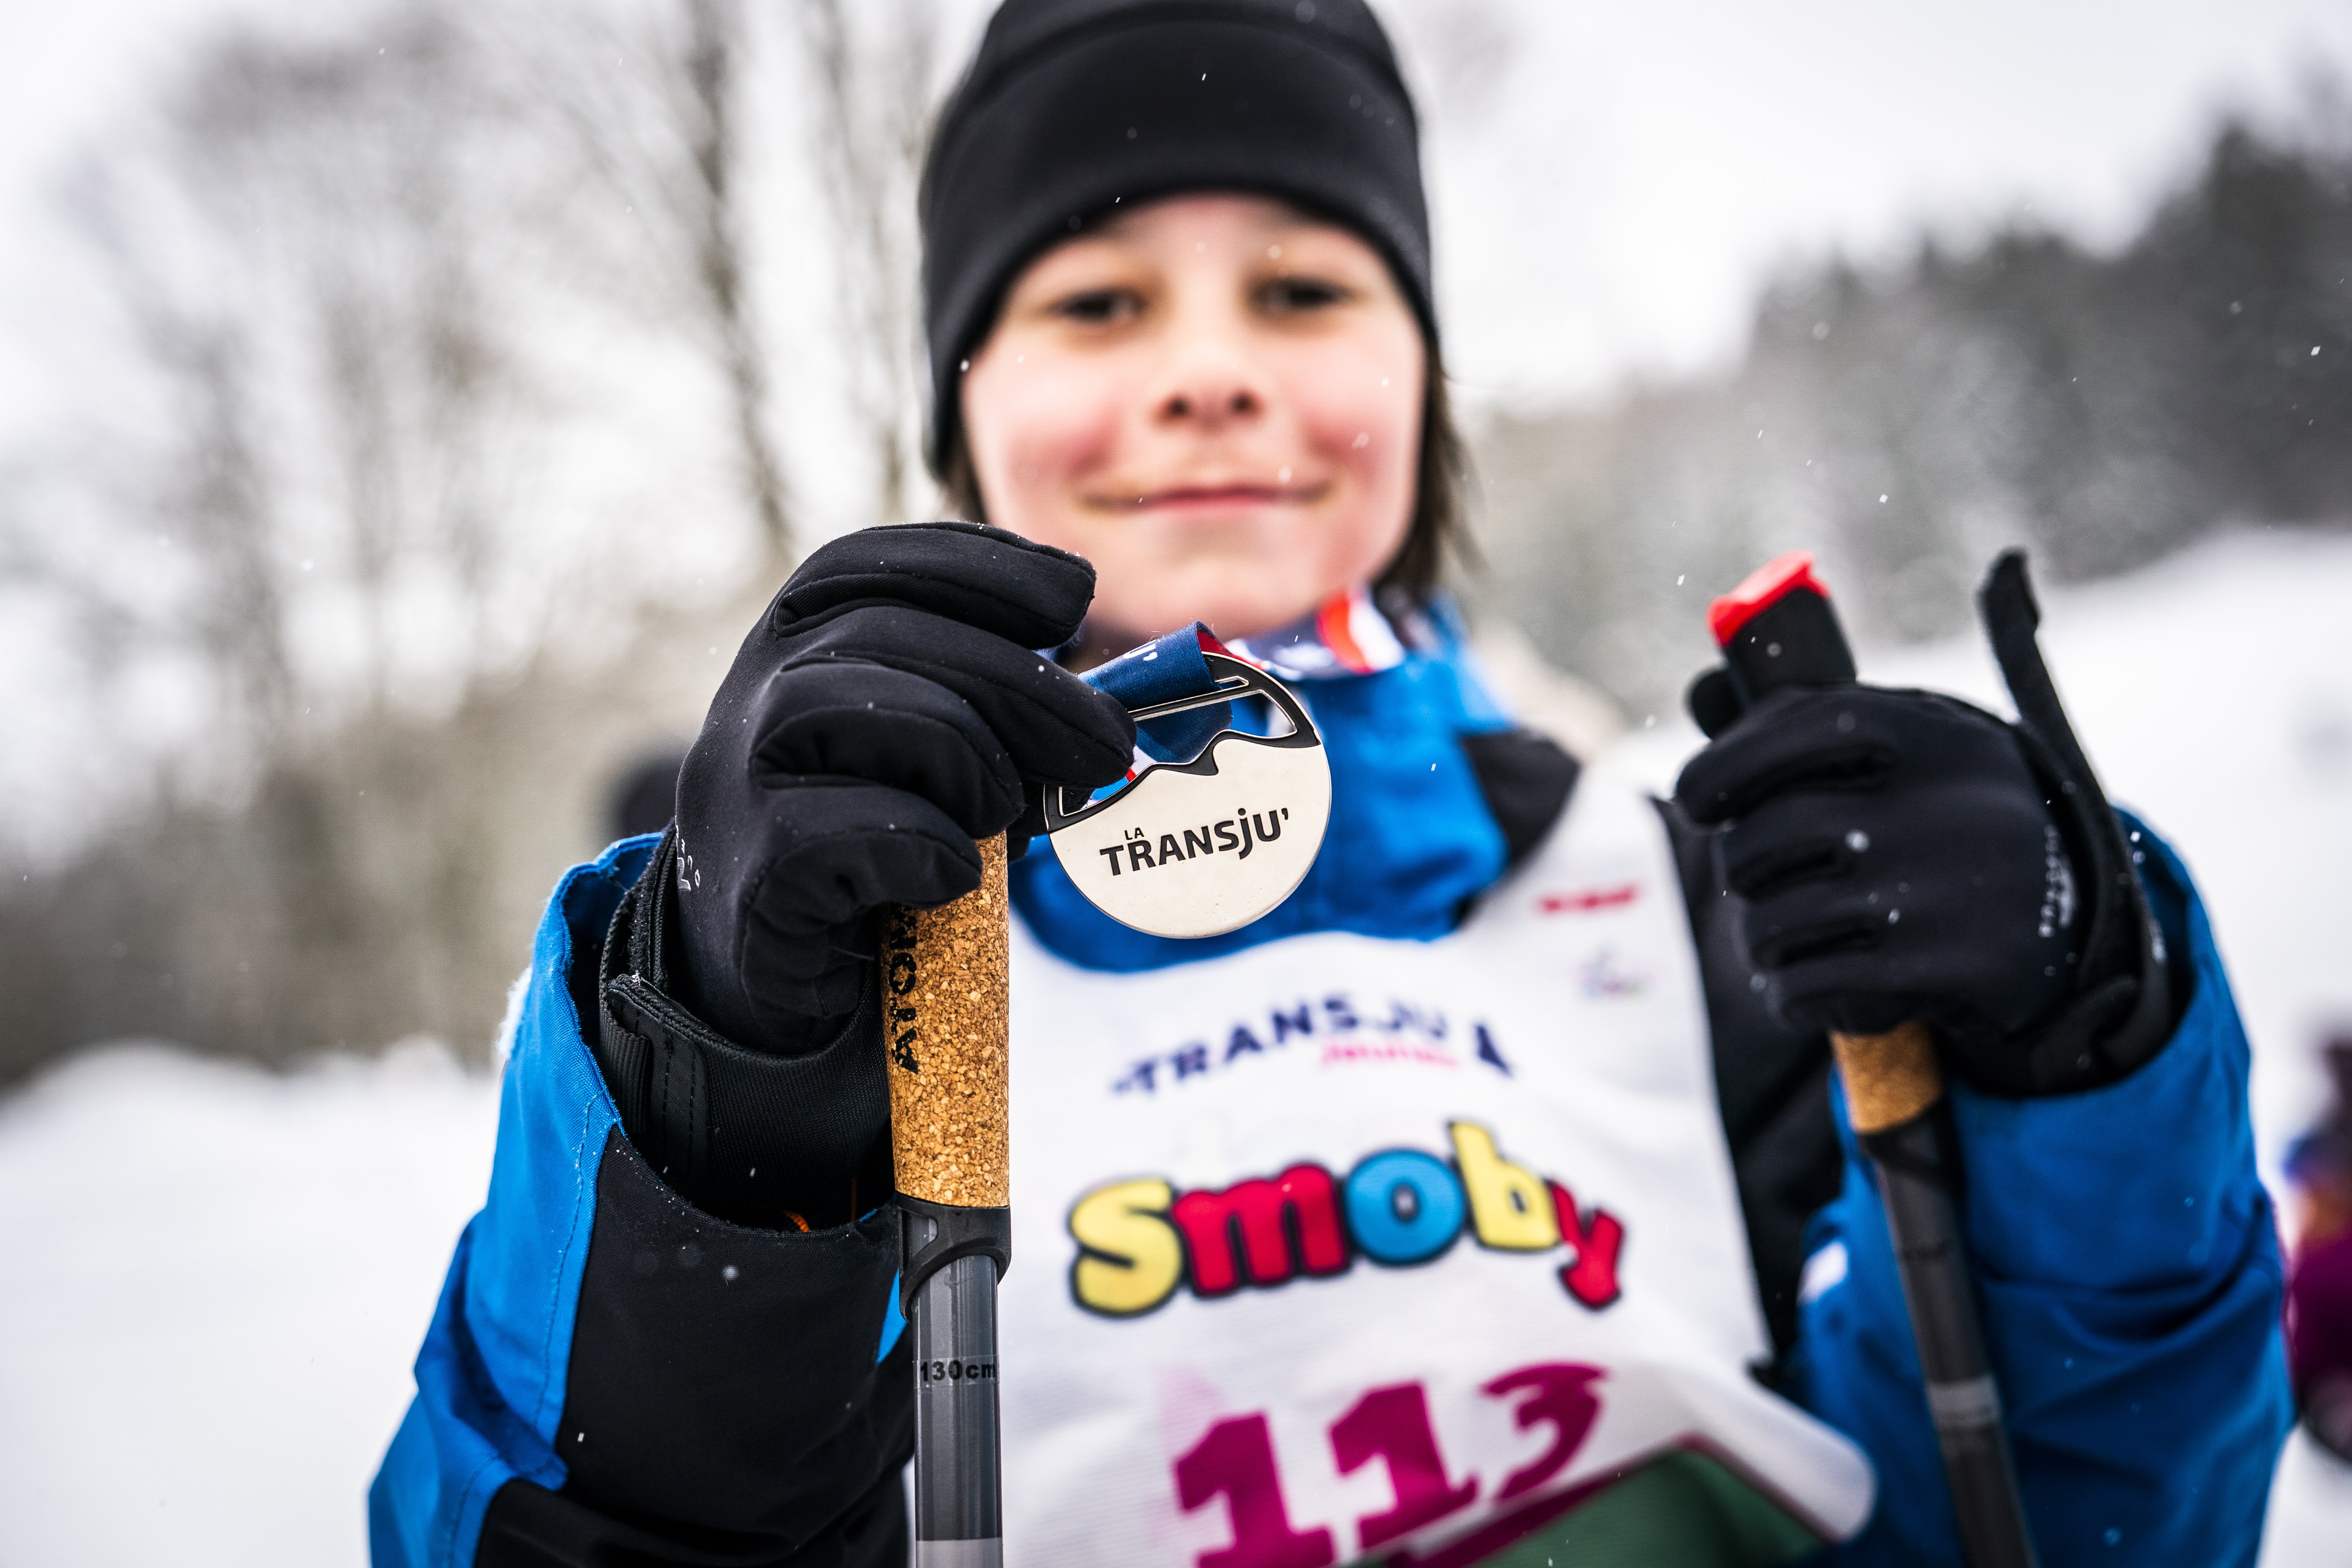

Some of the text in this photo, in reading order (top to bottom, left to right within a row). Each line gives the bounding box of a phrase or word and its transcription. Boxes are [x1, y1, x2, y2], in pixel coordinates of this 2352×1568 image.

[1124, 827, 1145, 840] LA
[1067, 1117, 1627, 1319] smoby
[921, 1359, 996, 1381] 130cm
